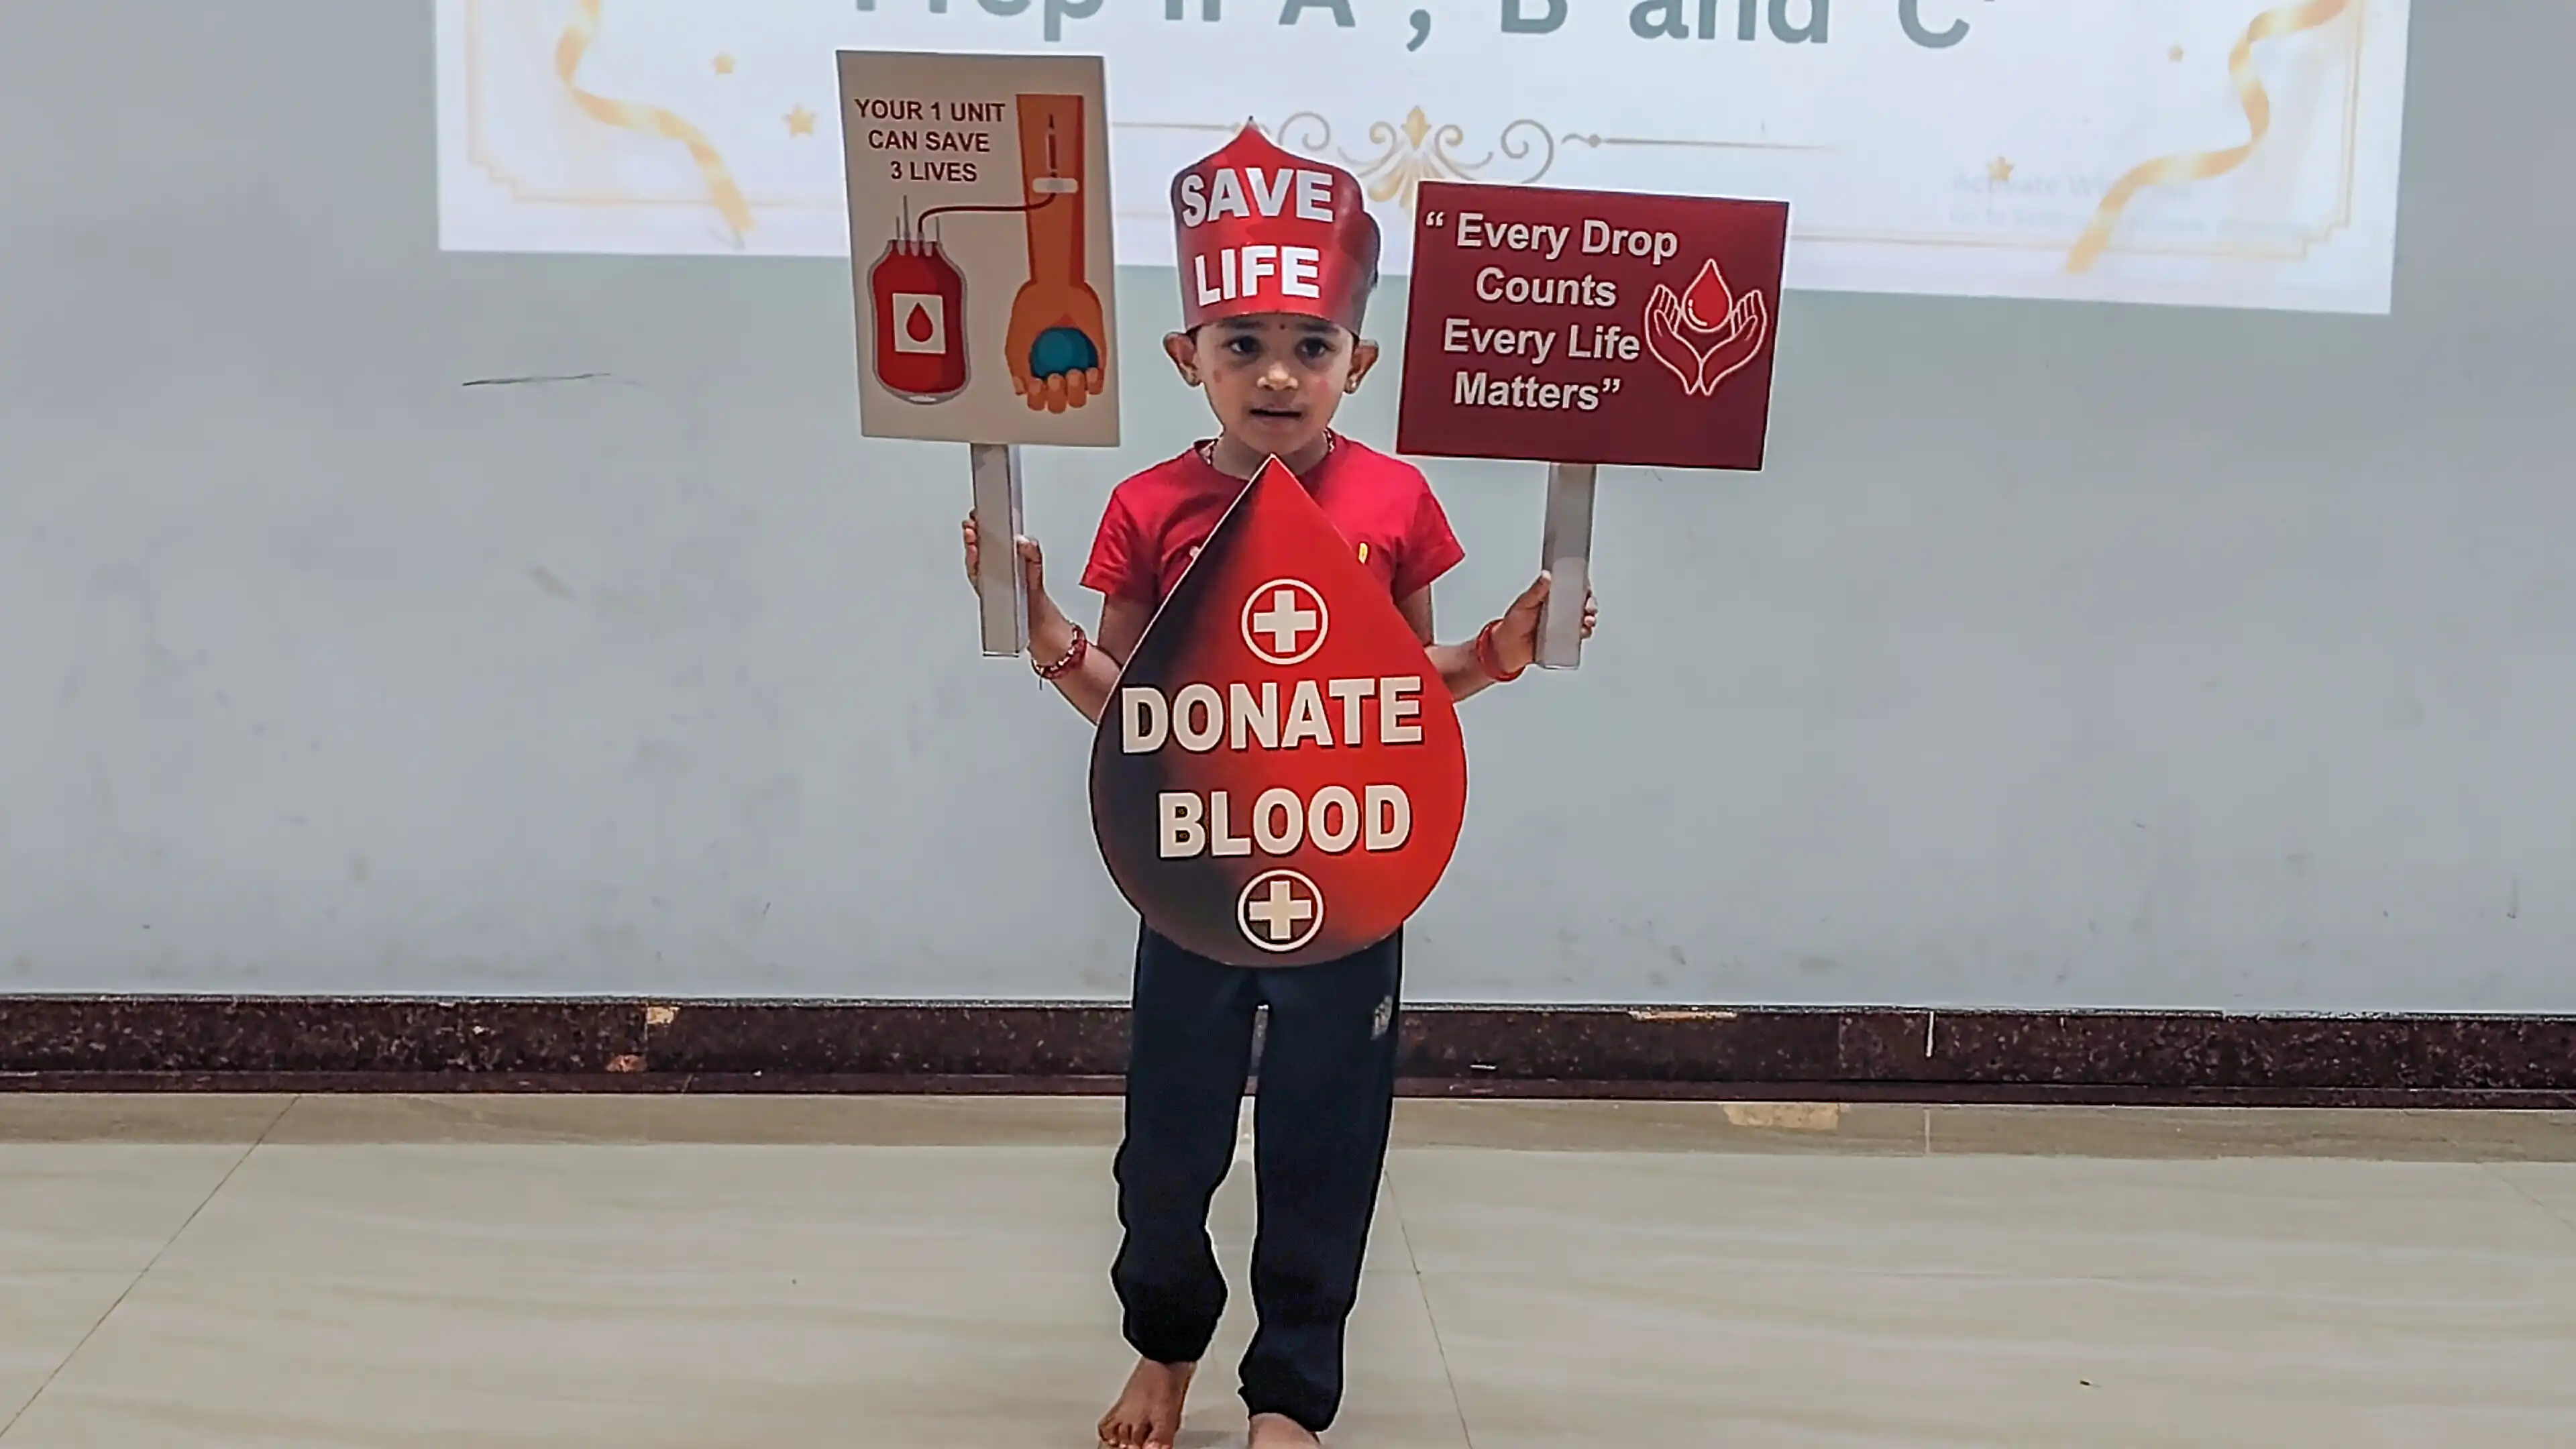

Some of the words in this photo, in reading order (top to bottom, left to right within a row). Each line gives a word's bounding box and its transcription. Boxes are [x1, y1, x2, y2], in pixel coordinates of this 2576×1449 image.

[1629, 0, 1829, 44] and
[854, 99, 924, 120] YOUR
[931, 102, 941, 120] 1
[951, 103, 1006, 123] UNIT
[868, 130, 917, 150] CAN
[925, 132, 991, 152] SAVE
[891, 161, 902, 180] 3
[910, 162, 977, 182] LIVES
[1181, 167, 1334, 228] SAVE
[1456, 212, 1570, 260] Every
[1582, 219, 1677, 265] Drop
[1194, 244, 1320, 307] LIFE
[1476, 267, 1617, 307] Counts
[1444, 318, 1556, 364] Every
[1568, 325, 1640, 361] Life
[1454, 372, 1621, 411] Matters”
[1122, 676, 1423, 754] DONATE
[1159, 784, 1411, 859] BLOOD
